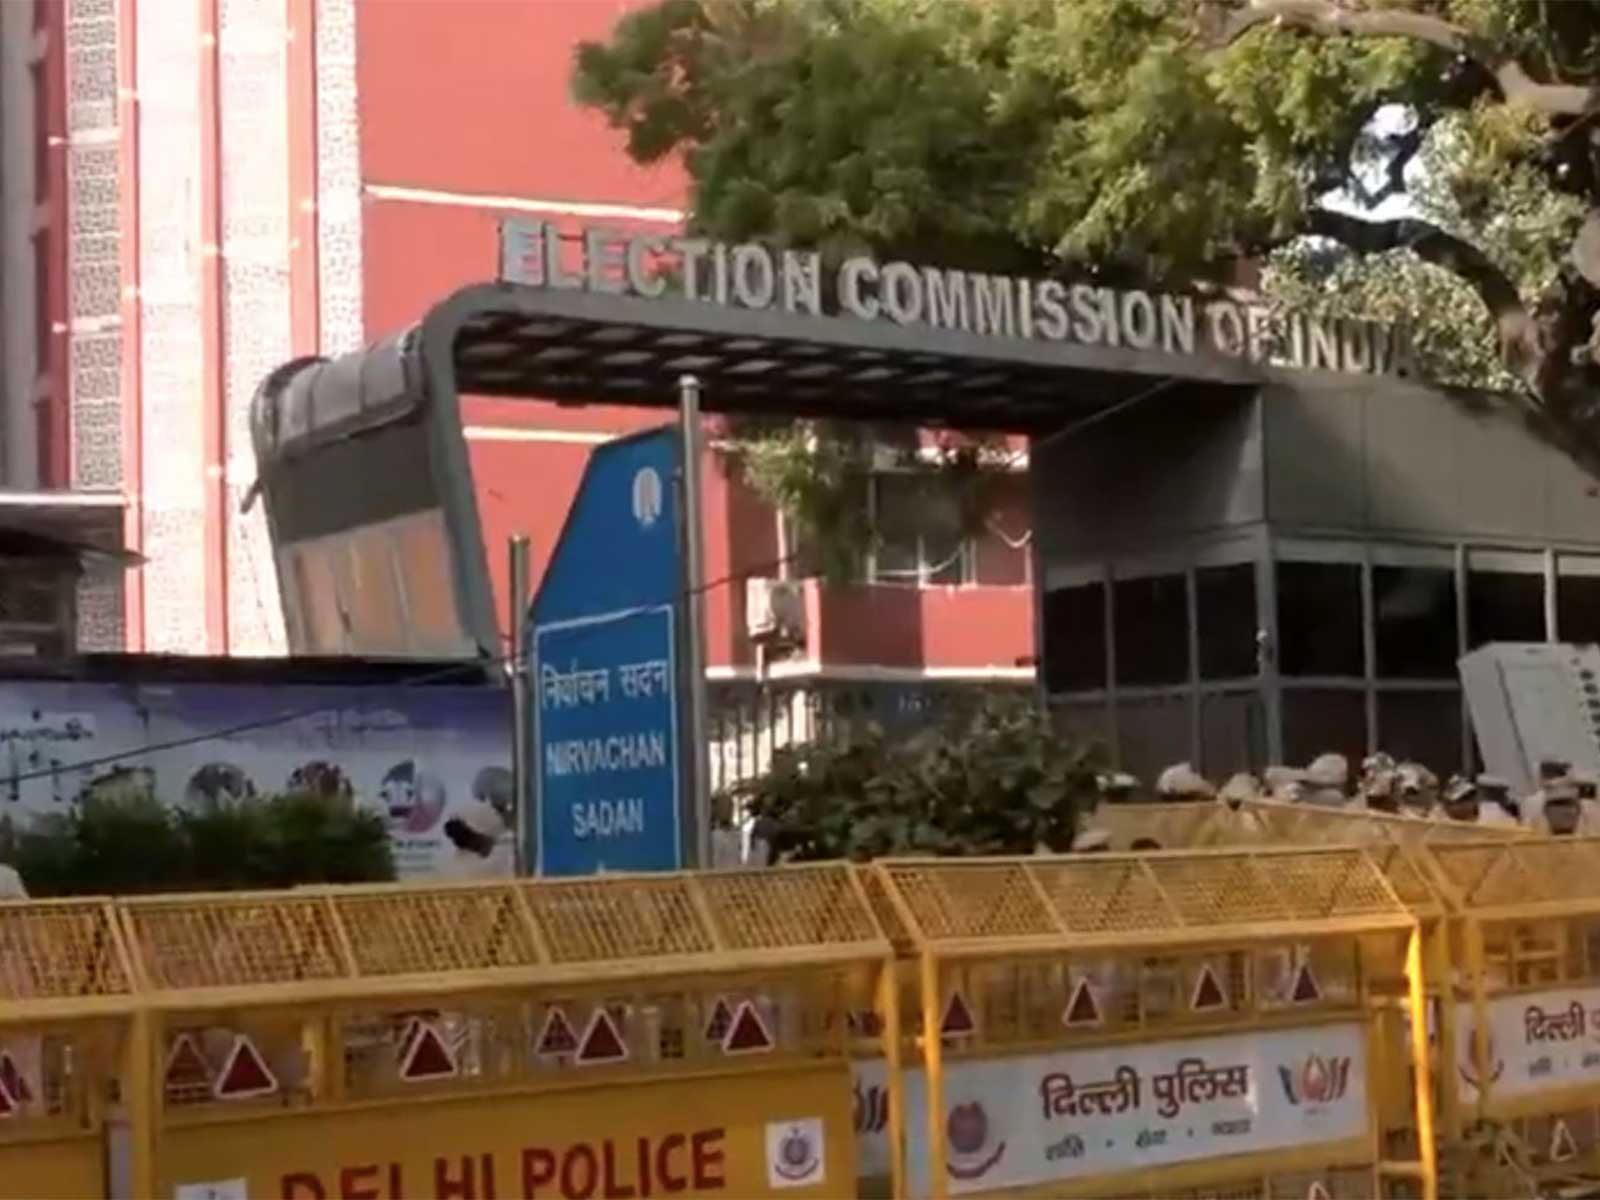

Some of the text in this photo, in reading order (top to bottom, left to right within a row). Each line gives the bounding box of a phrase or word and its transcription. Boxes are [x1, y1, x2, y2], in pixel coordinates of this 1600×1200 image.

[503, 217, 1408, 377] ELECTION COMMISSION OF INDI
[541, 658, 667, 710] निर्वाचन सदन
[545, 730, 666, 777] NIRVACHAN
[571, 798, 644, 838] SADAN
[1524, 1000, 1586, 1045] दिल्ली
[1041, 1057, 1250, 1119] दिल्ली पुलिस
[521, 1127, 726, 1200] POLICE
